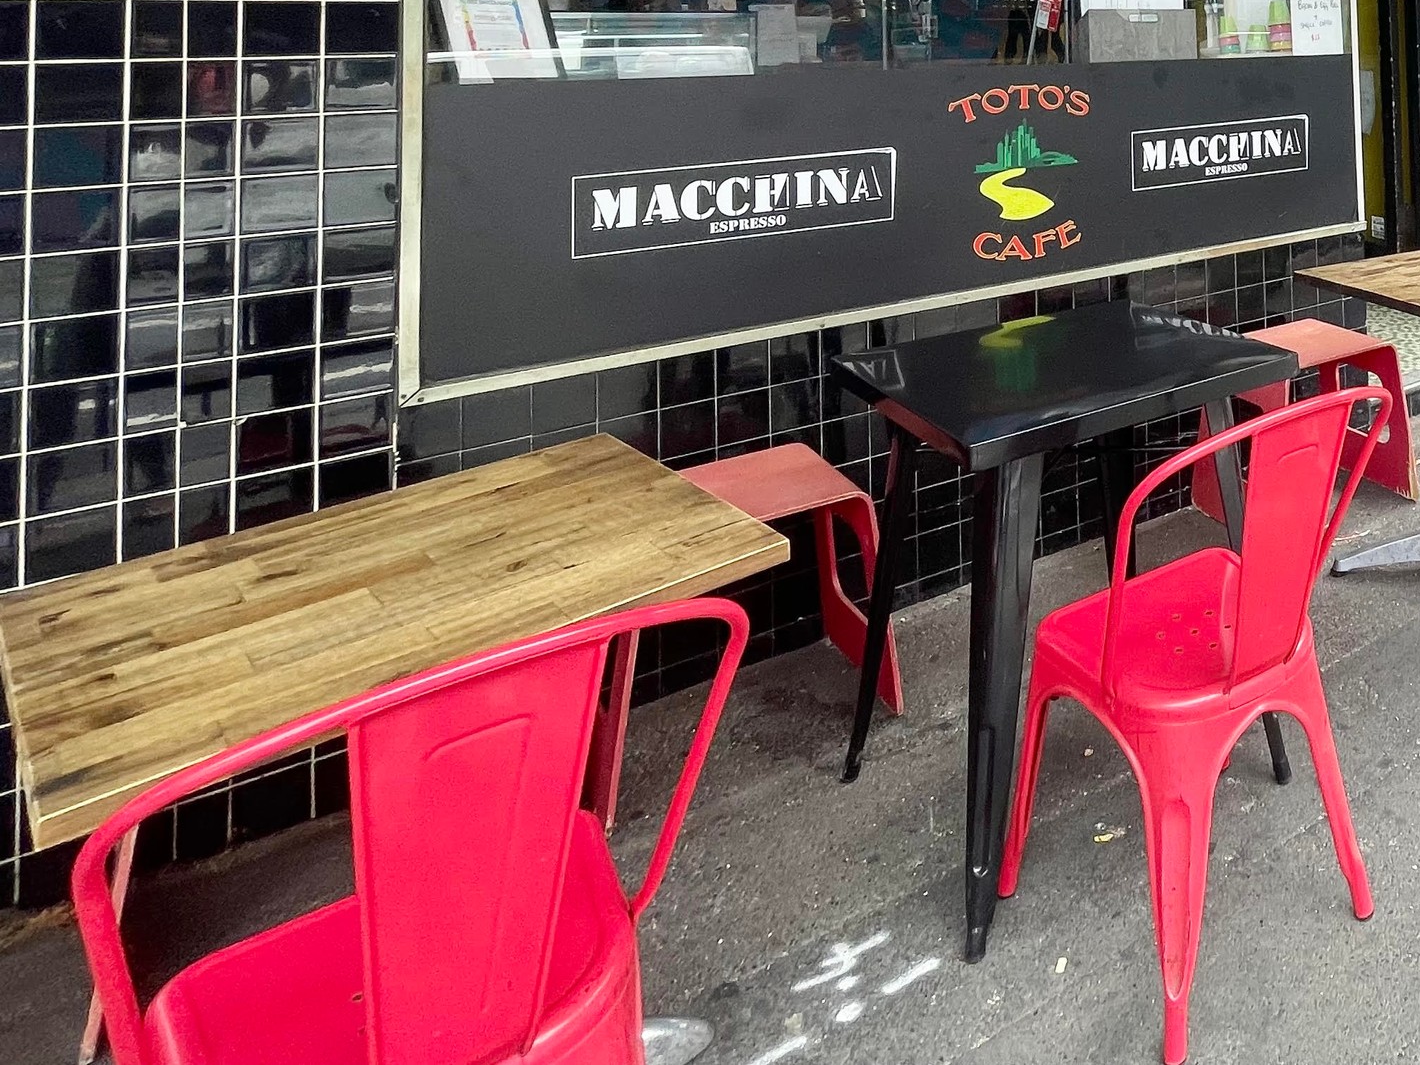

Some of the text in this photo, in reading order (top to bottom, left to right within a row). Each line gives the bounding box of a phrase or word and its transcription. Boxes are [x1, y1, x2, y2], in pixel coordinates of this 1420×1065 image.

[948, 84, 1091, 123] TOTO'S
[1142, 128, 1301, 171] MACCHINA
[1205, 163, 1248, 176] ESPRESSO
[591, 165, 883, 231] MACCHINA
[710, 214, 787, 234] ESPRESSO
[973, 219, 1082, 261] CAFE
